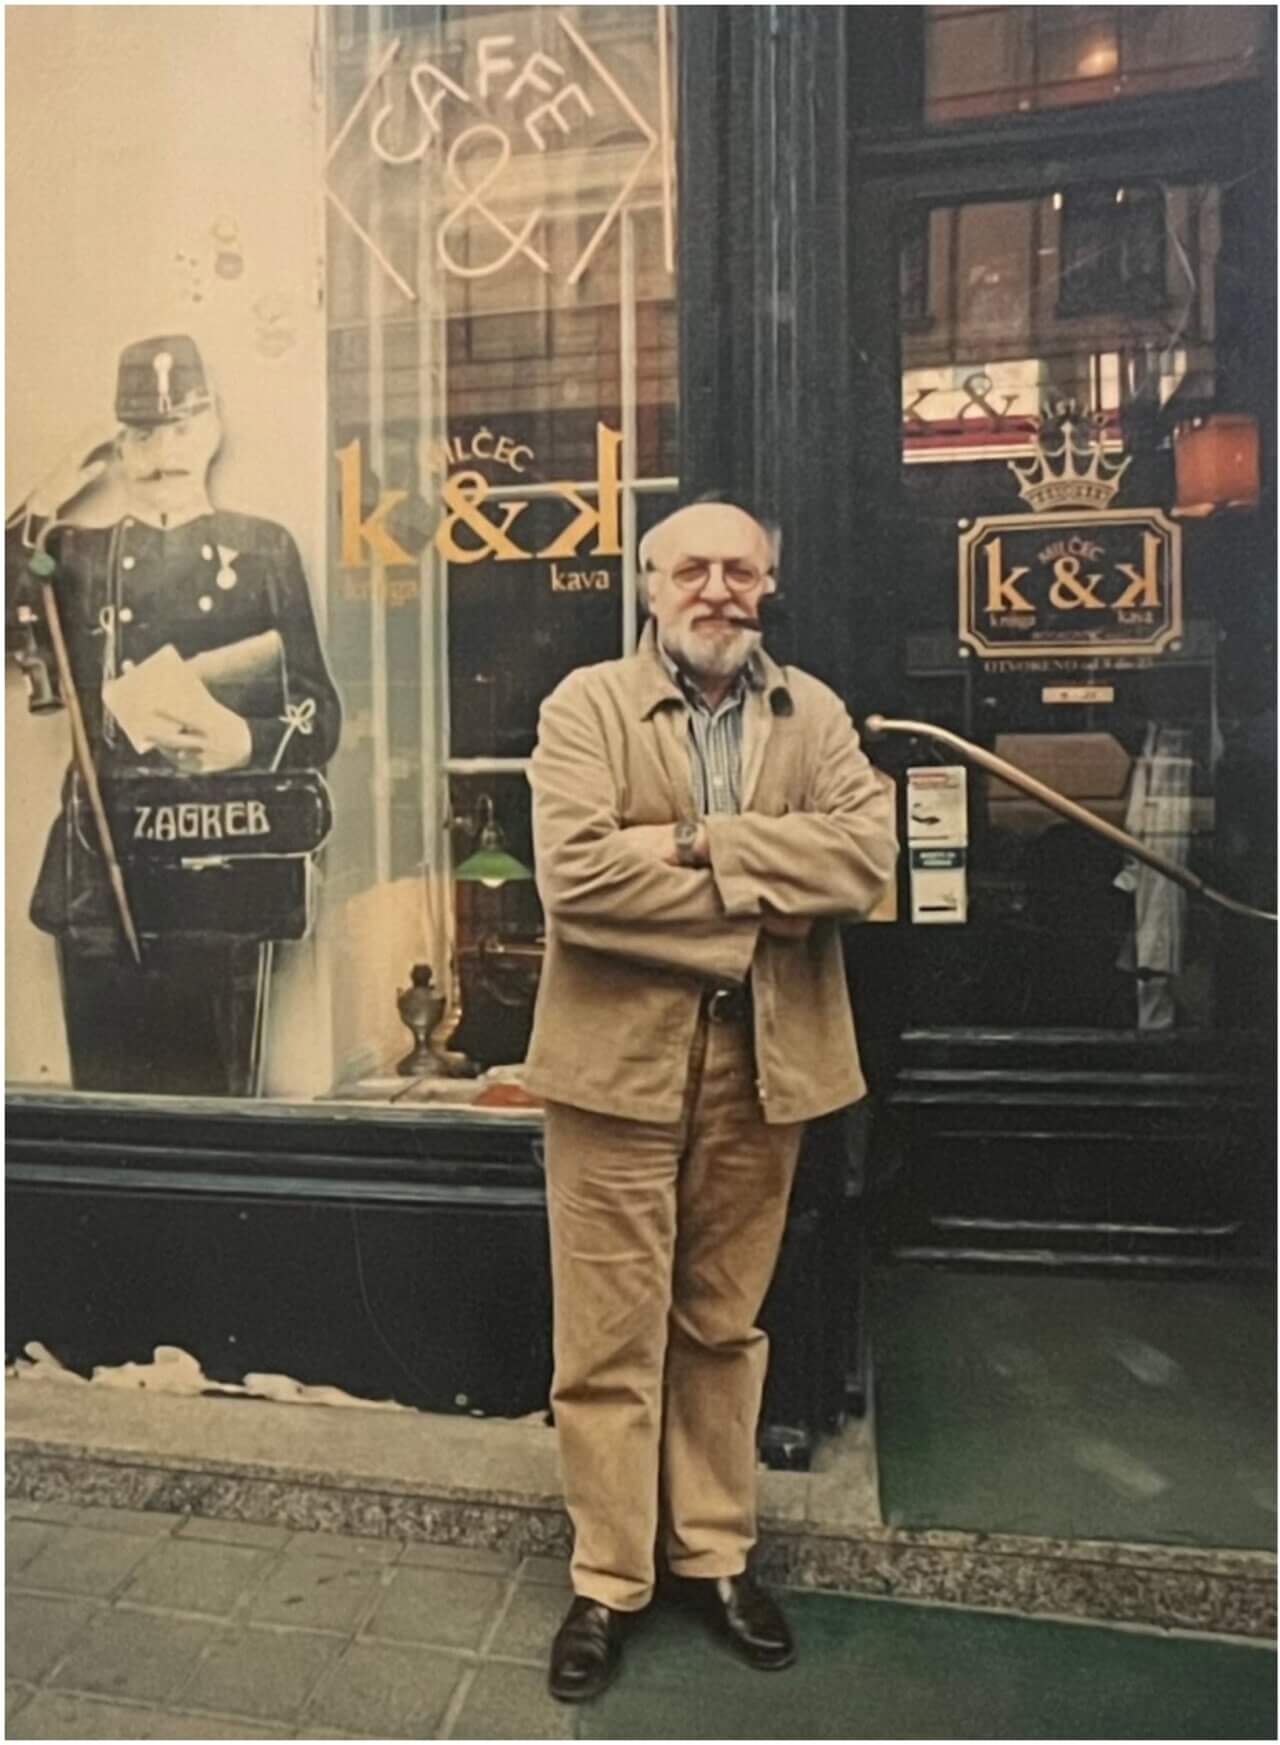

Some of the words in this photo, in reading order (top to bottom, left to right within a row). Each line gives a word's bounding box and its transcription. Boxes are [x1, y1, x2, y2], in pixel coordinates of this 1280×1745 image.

[371, 36, 595, 163] CAFFE
[551, 563, 610, 592] kava
[134, 801, 270, 840] ZAGREB
